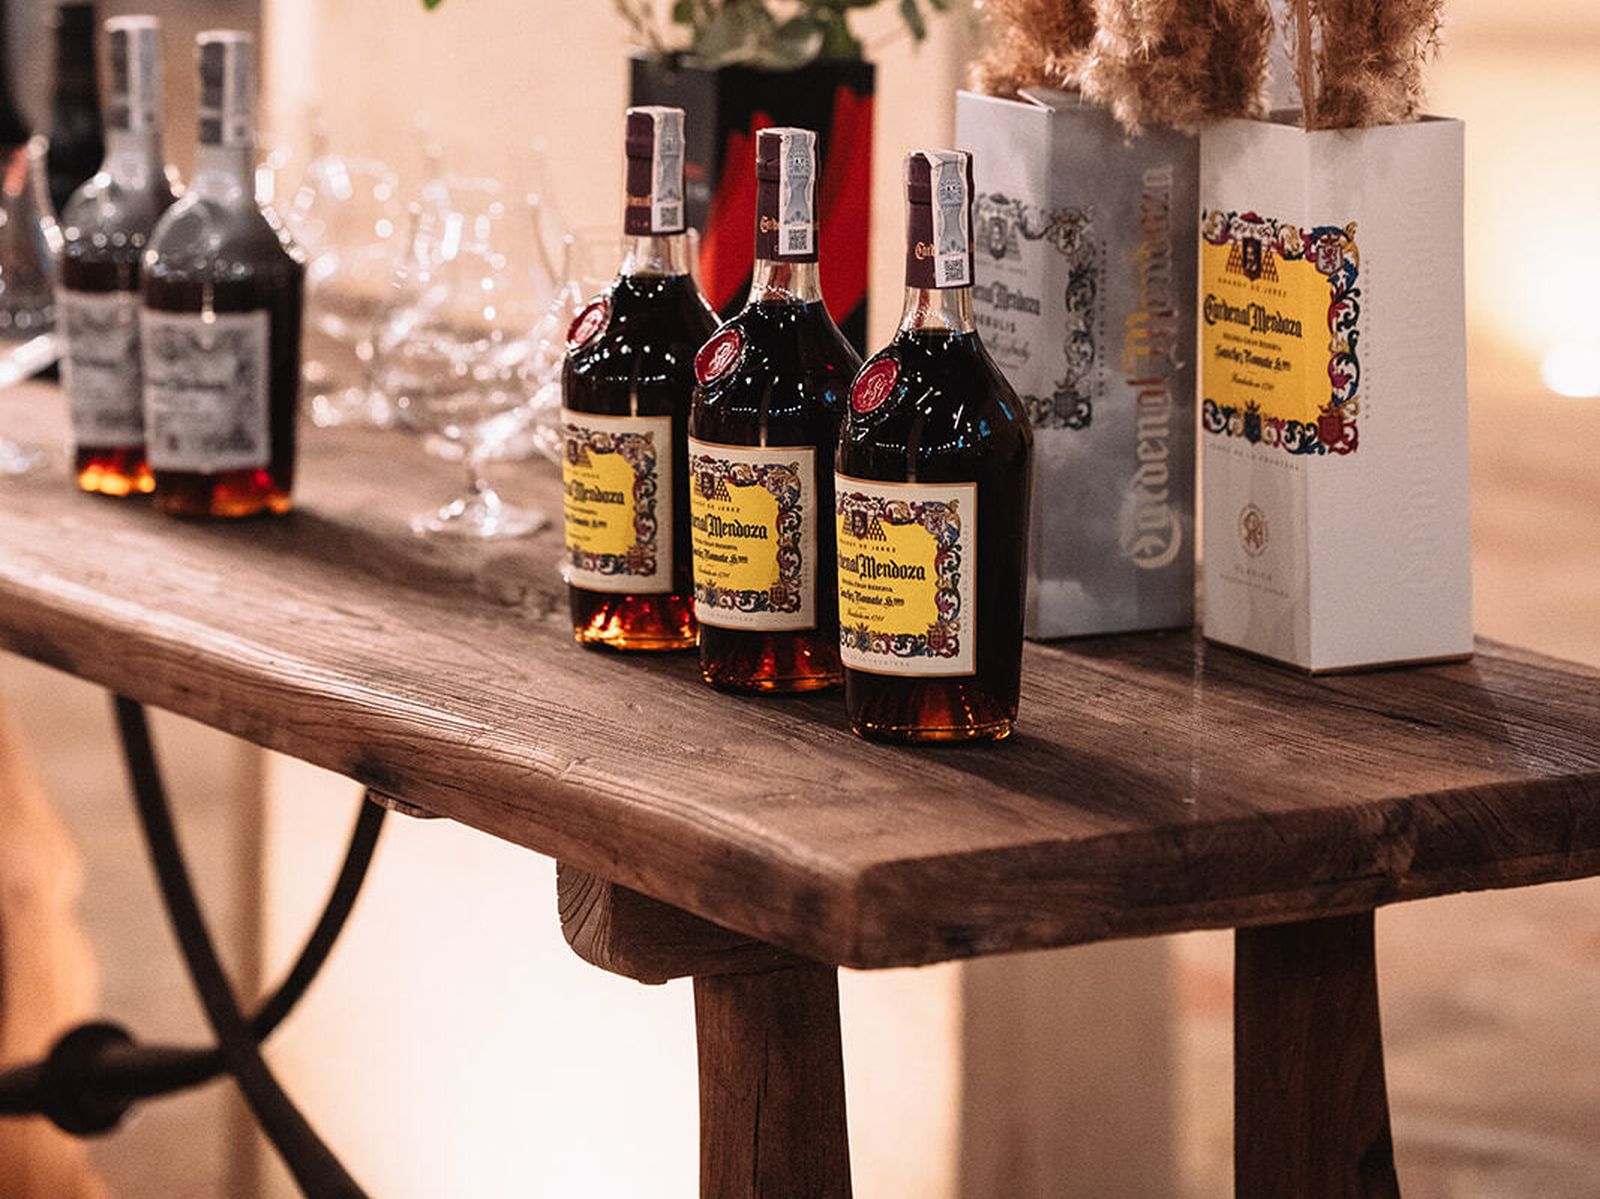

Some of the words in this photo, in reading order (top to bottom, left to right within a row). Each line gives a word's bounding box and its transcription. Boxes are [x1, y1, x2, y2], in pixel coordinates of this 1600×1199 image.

[1122, 163, 1184, 375] Mendoza
[1203, 293, 1250, 326] Cardenal
[1248, 302, 1302, 338] Mendoza
[1120, 376, 1182, 569] Cardenal
[707, 512, 768, 540] Mendoza
[858, 553, 926, 581] Mendoza
